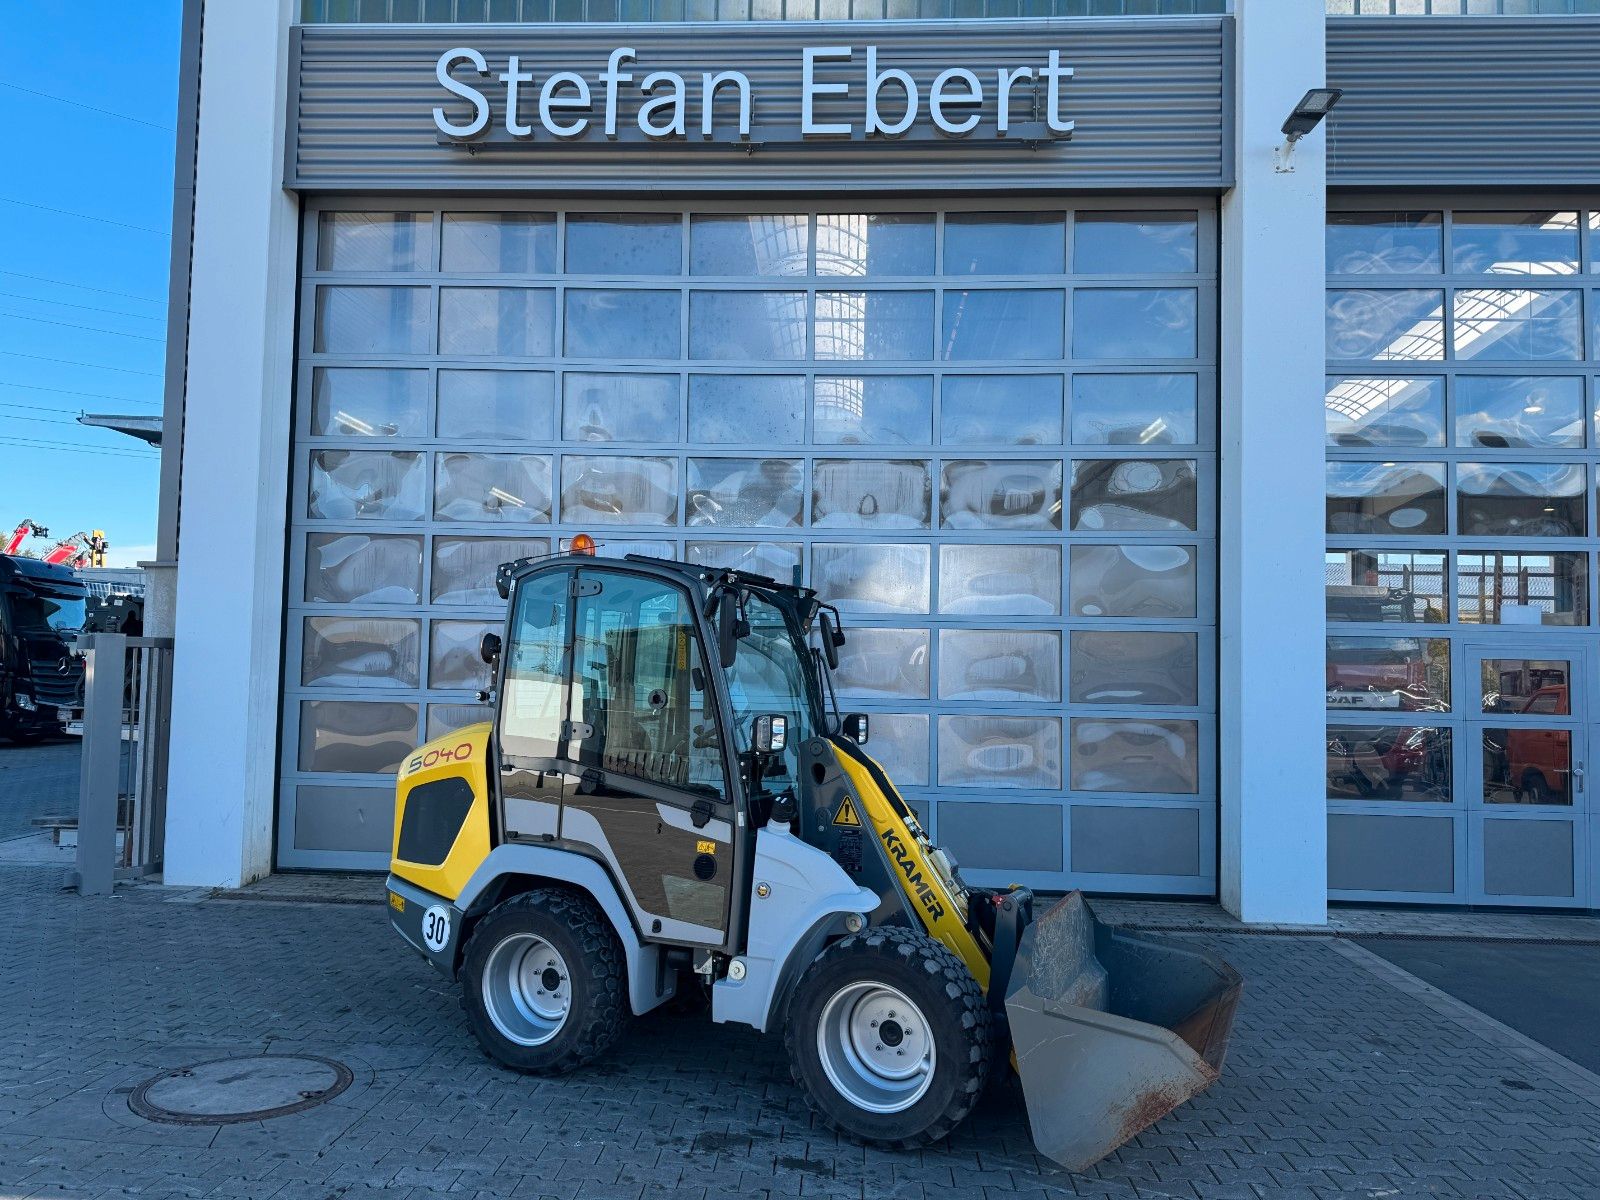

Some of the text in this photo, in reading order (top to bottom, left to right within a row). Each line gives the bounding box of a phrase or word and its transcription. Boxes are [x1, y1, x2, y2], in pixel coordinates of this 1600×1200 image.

[432, 45, 1075, 138] Stefan Ebert
[1326, 696, 1364, 704] DAF
[408, 743, 472, 774] 5040
[882, 829, 945, 922] KRAMER
[426, 912, 446, 944] 30
